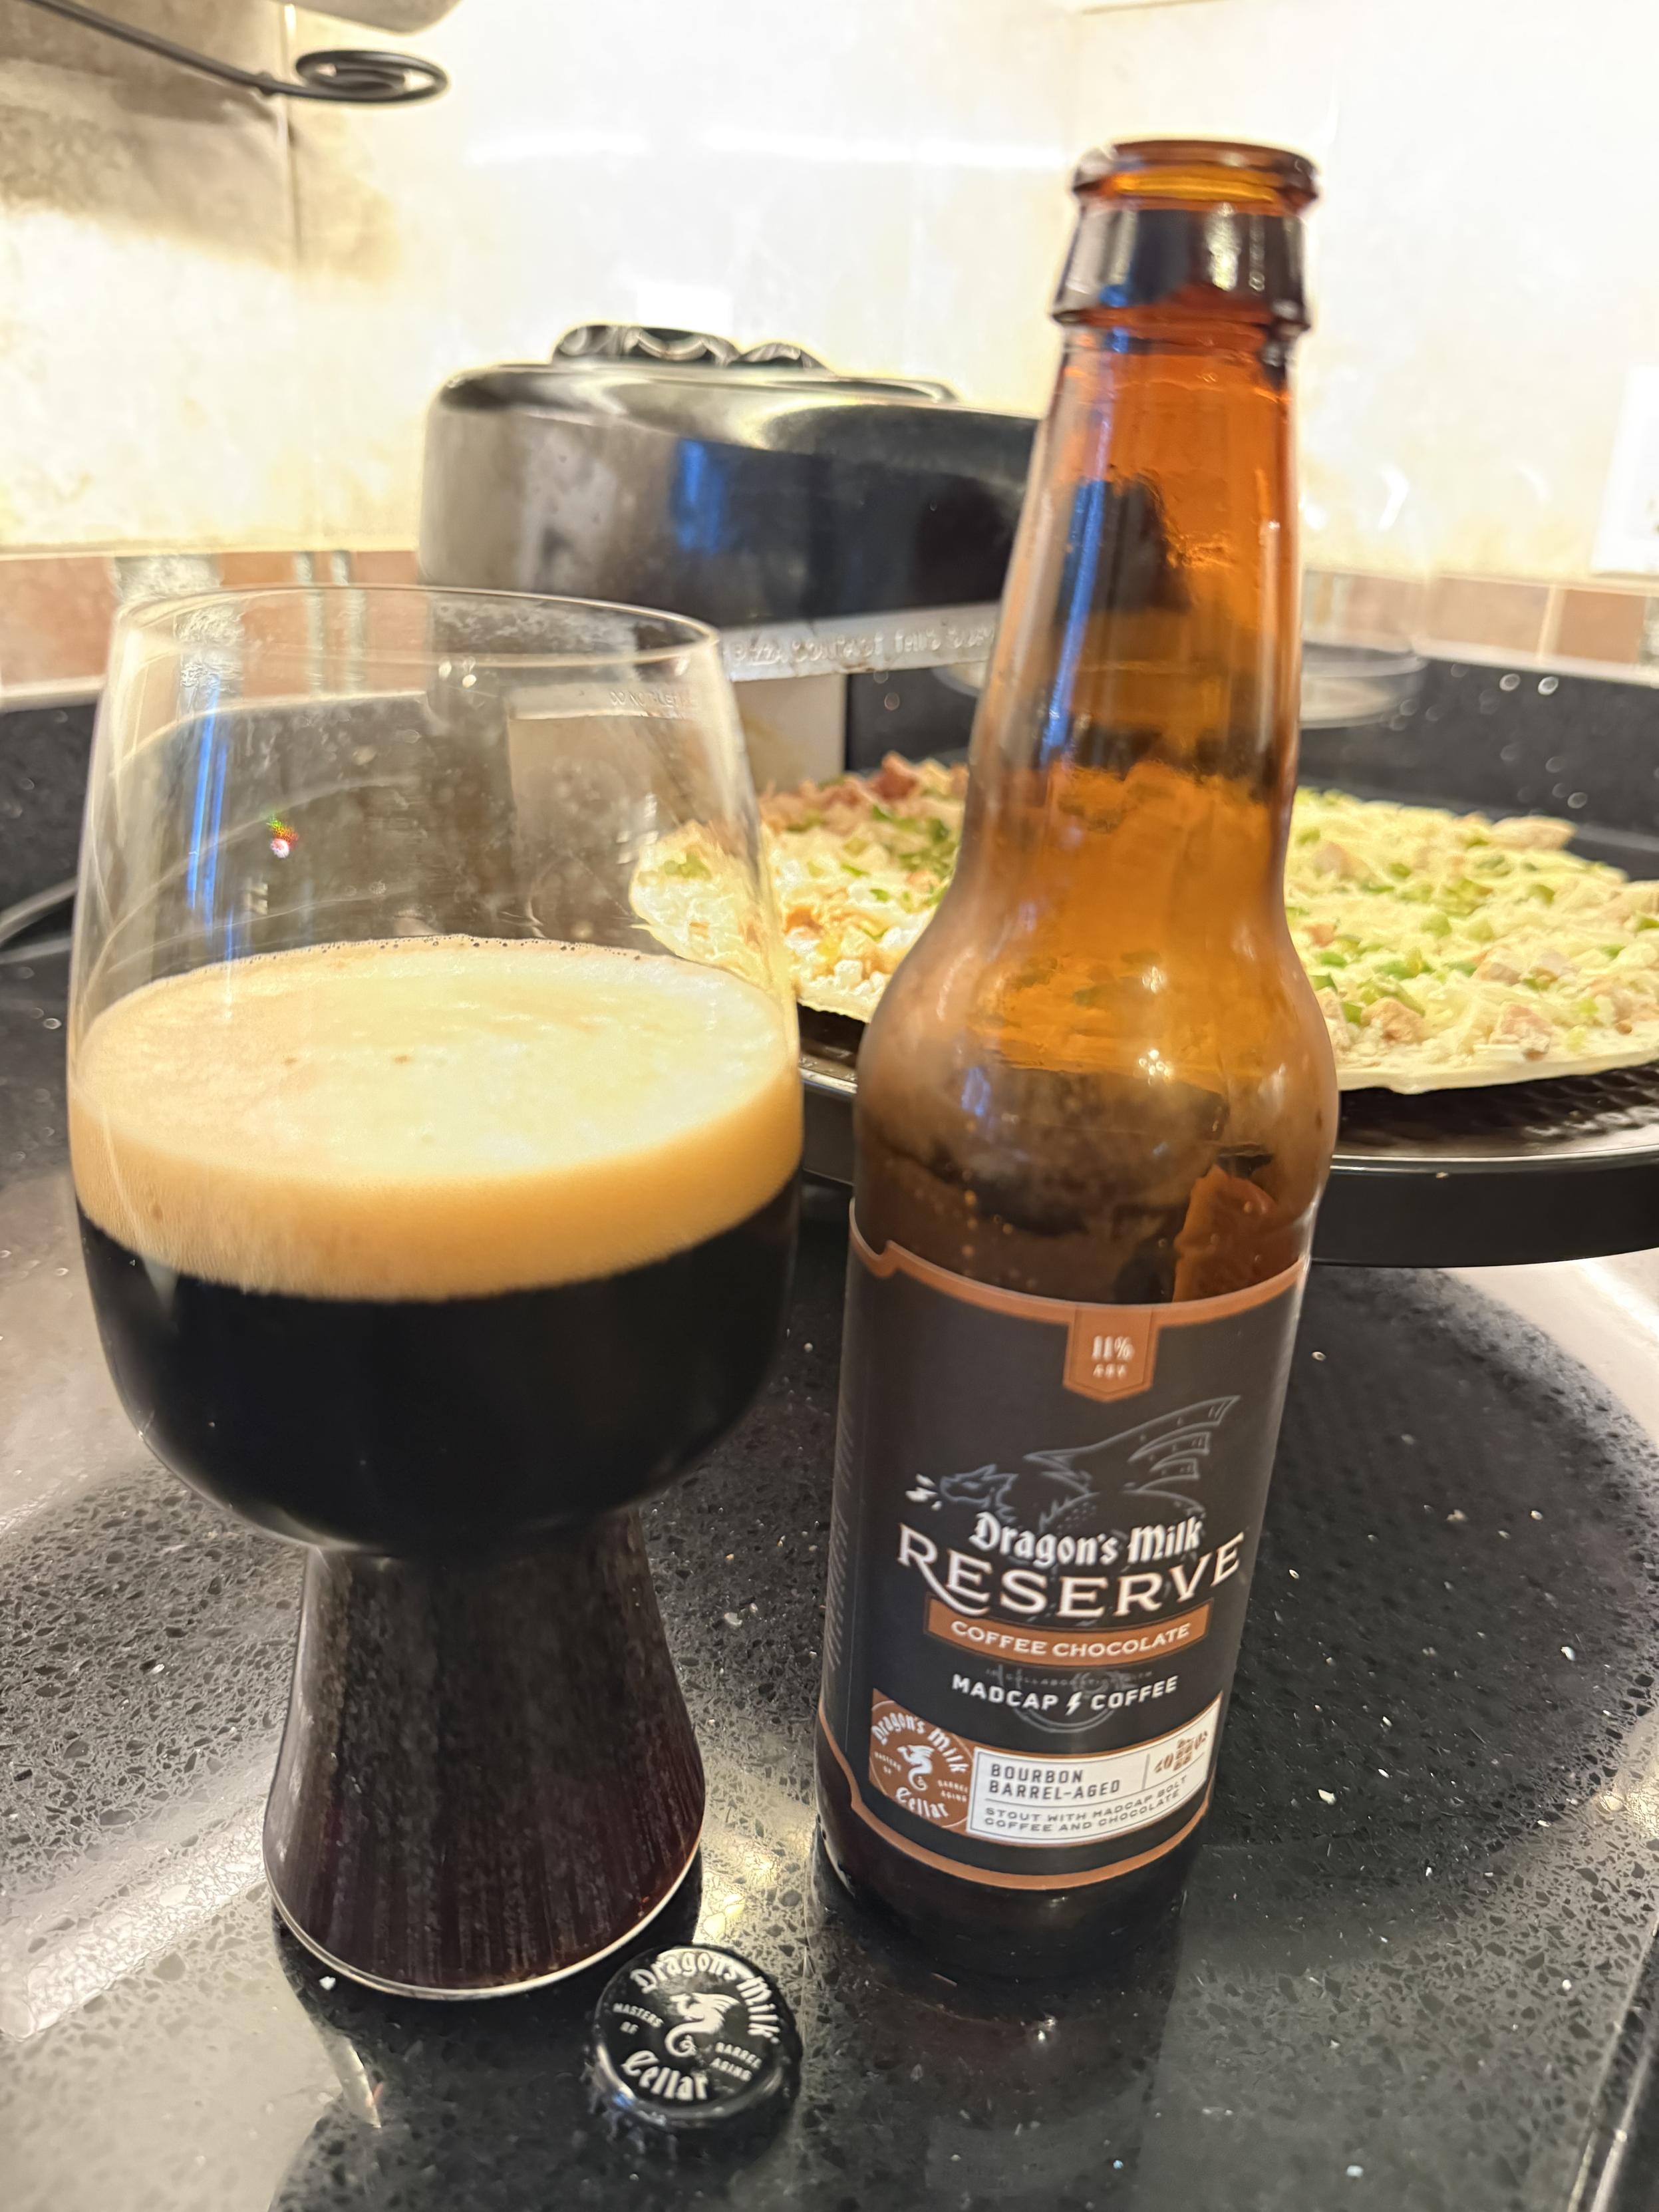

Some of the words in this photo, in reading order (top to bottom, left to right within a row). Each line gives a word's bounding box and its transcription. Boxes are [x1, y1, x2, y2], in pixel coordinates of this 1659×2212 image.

[1092, 1335, 1135, 1362] 11%
[969, 1511, 1118, 1569] Dragon's
[1127, 1516, 1203, 1564] Milk
[897, 1521, 1245, 1618] RESERVE
[951, 1620, 1048, 1656] COFFEE
[1052, 1622, 1192, 1658] CHOCOLATE
[952, 1673, 1059, 1710] MADCAP
[1090, 1674, 1179, 1710] COFFEE
[871, 1712, 925, 1746] Dragon's
[927, 1727, 969, 1773] Milk
[988, 1779, 1120, 1800] BARREL-AGED
[991, 1763, 1084, 1784] BOURBON
[895, 1786, 950, 1819] Cellar
[984, 1817, 1053, 1831] COFFEE
[1058, 1821, 1092, 1831] AND
[1098, 1789, 1180, 1827] CHOCOLATE
[985, 1807, 1042, 1821] STOUT
[1048, 1813, 1086, 1822] WITH
[1092, 1795, 1153, 1817] MADCAP
[1157, 1775, 1187, 1799] BOLT
[613, 2002, 665, 2028] MASTERS
[630, 1953, 738, 1994] Dragons
[735, 1975, 781, 2044] Milk
[619, 2021, 640, 2035] OF
[708, 2057, 754, 2082] AGING
[714, 2041, 763, 2069] BARREL
[621, 2049, 710, 2102] Cellar
